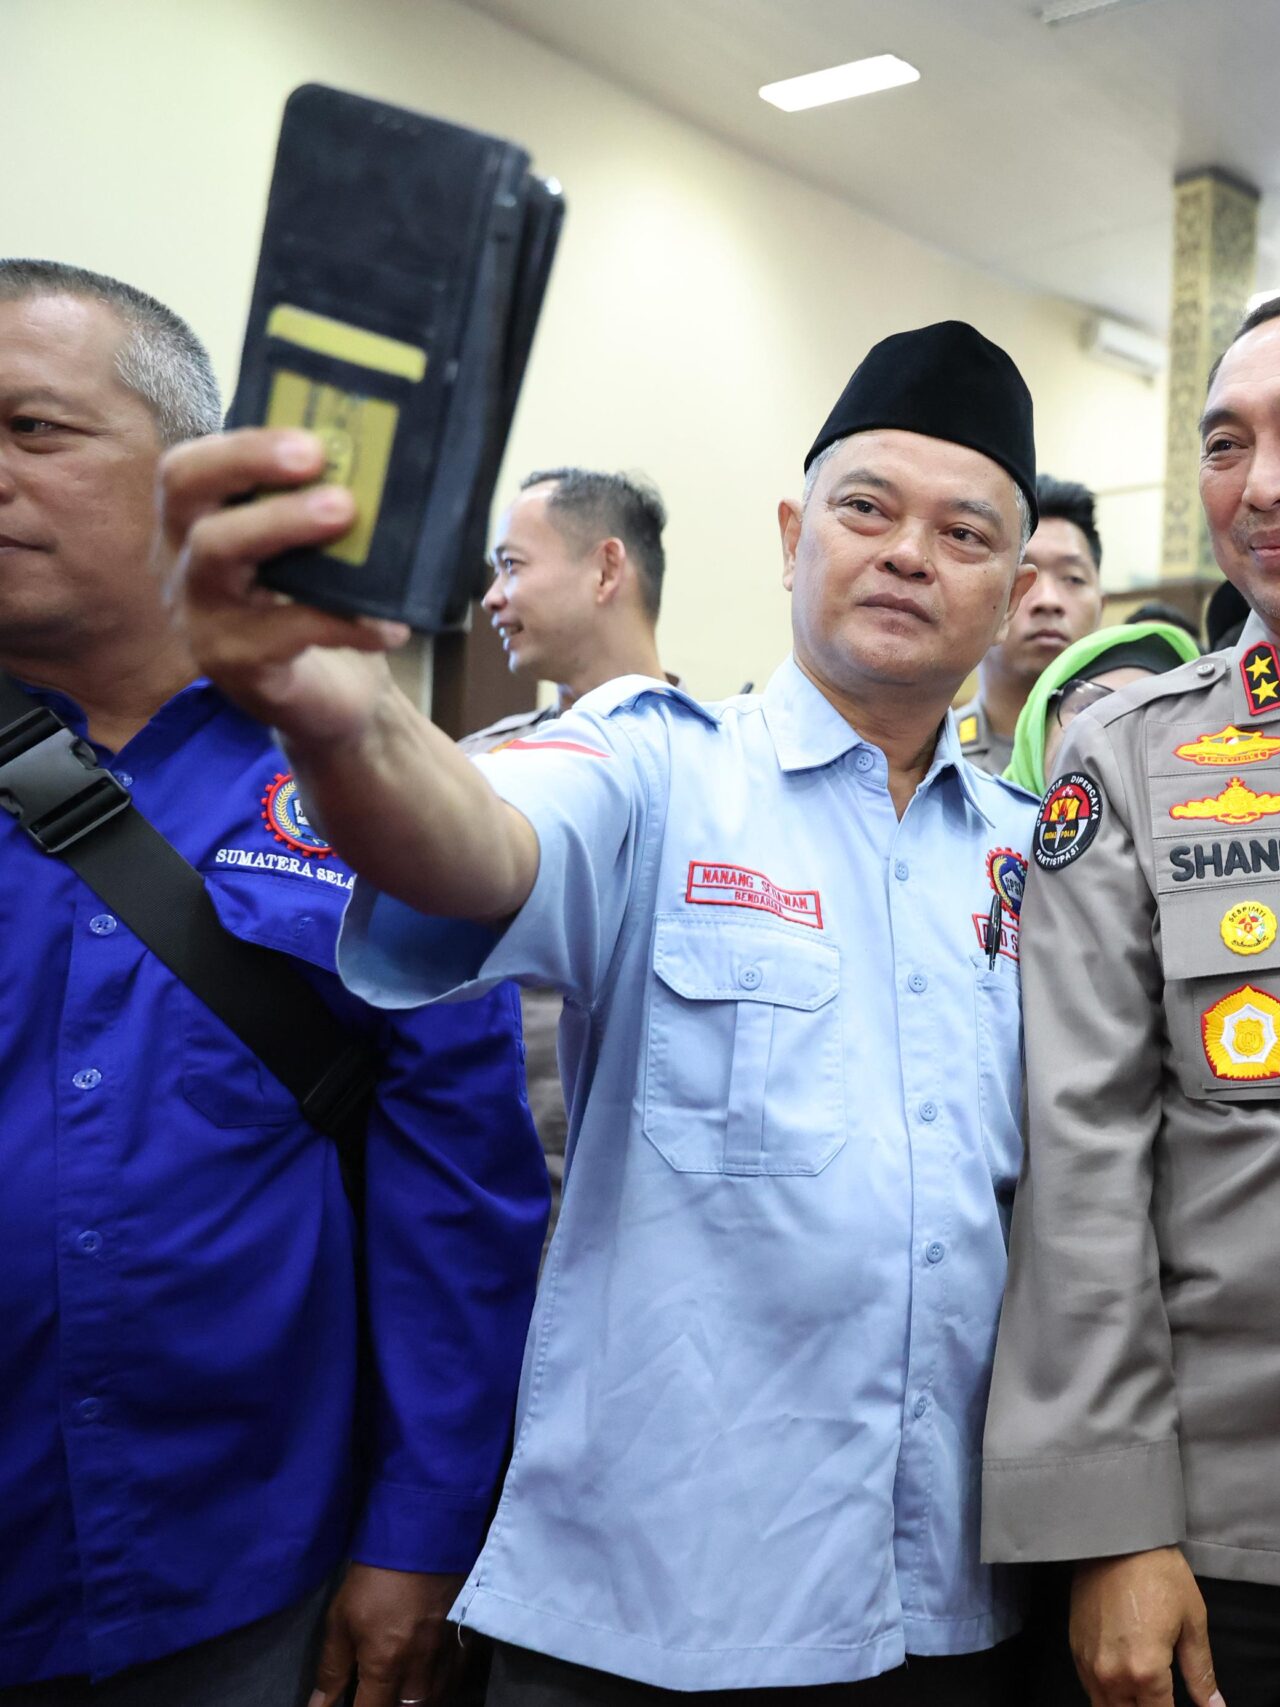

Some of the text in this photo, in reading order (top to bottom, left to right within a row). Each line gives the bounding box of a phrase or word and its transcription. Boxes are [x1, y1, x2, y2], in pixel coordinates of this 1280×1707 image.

[1070, 775, 1099, 820] DIPERCAYA
[215, 849, 313, 877] SUMATERA
[1036, 844, 1079, 866] PARTISIPASI
[702, 868, 754, 888] NANANG
